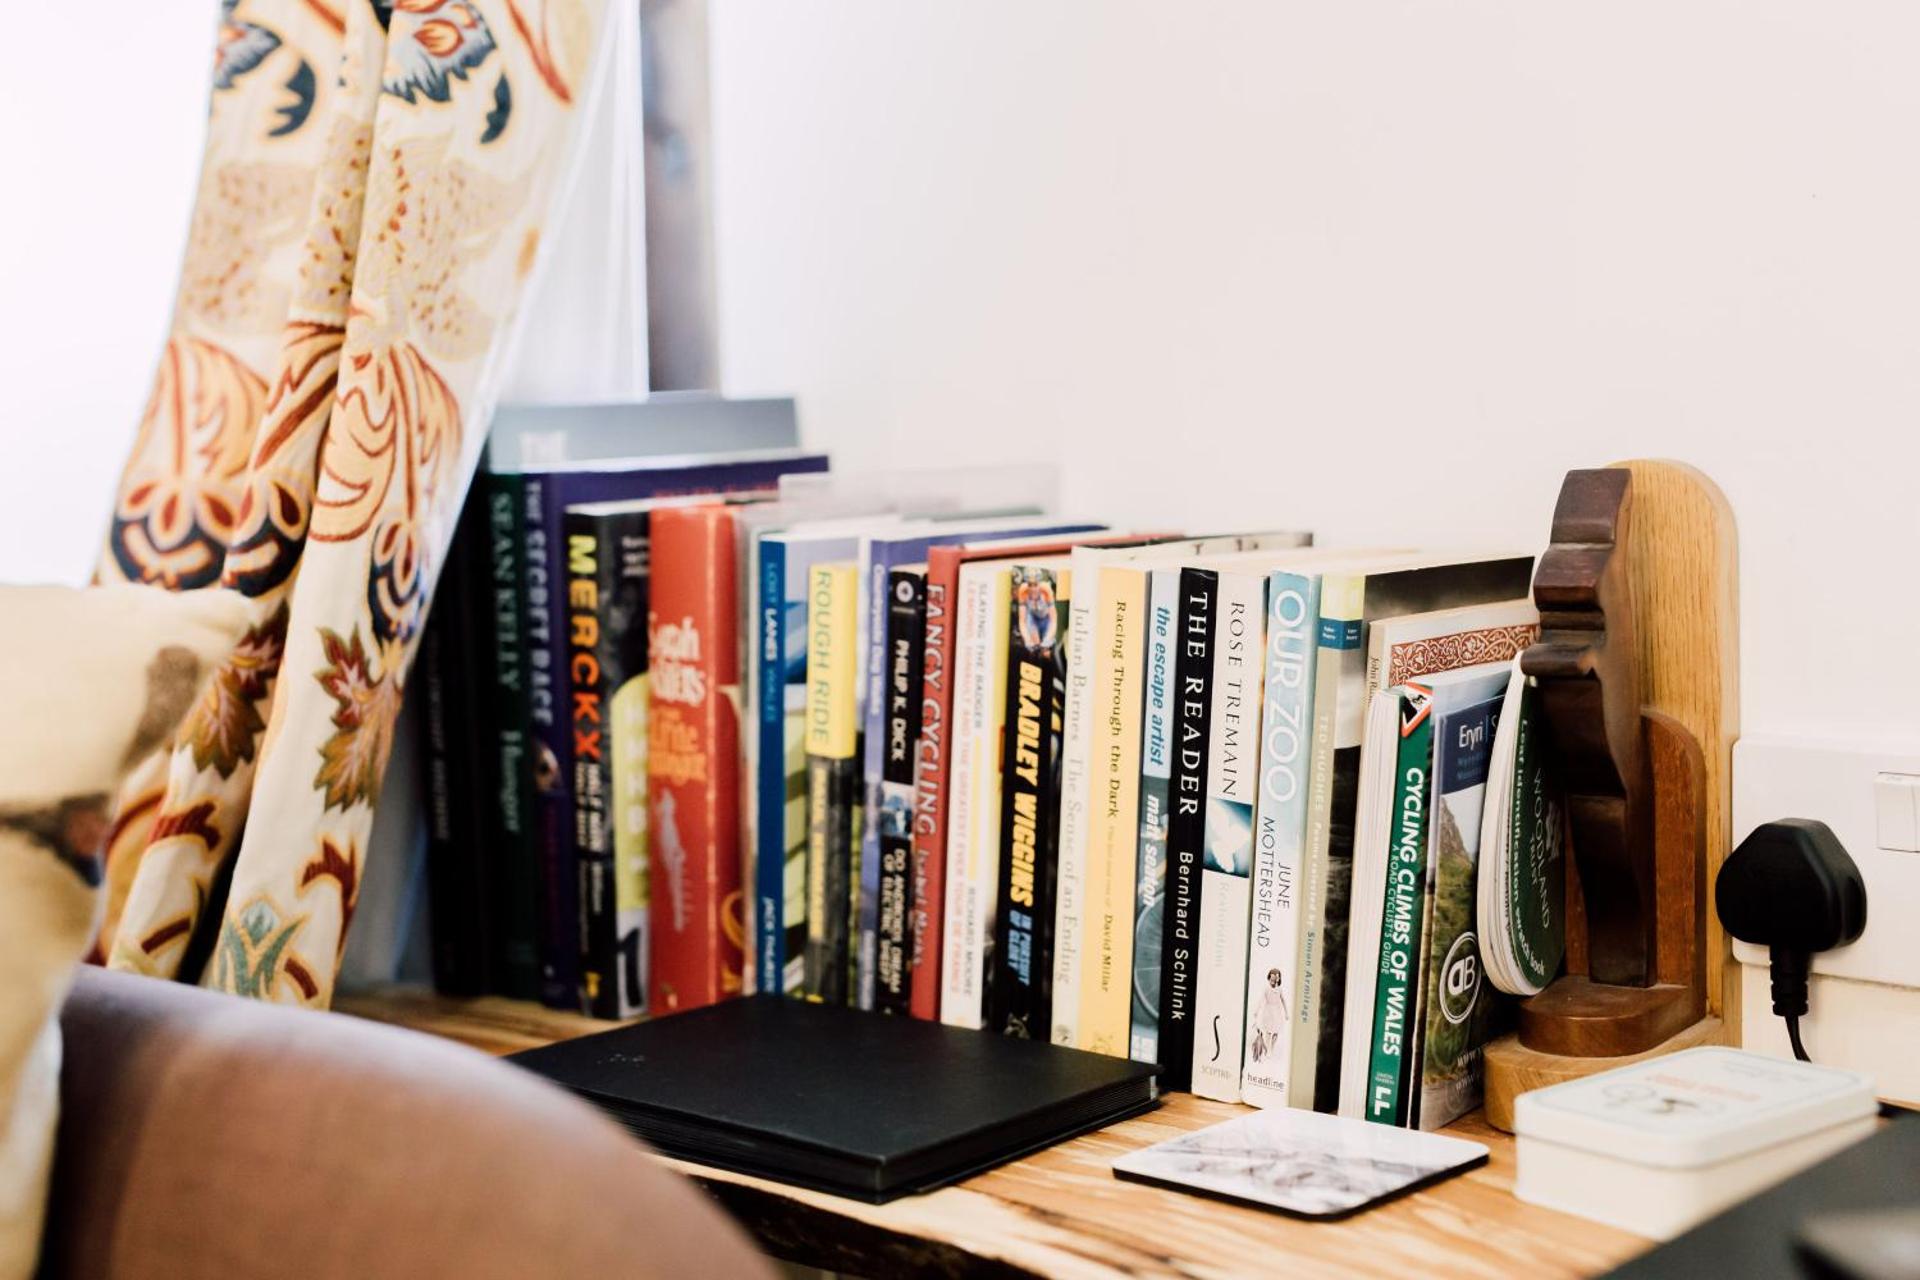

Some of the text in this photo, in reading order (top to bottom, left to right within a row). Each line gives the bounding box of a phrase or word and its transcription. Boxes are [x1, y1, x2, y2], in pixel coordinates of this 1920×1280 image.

[492, 493, 521, 690] SEAN KELLY
[526, 529, 550, 641] SECRET
[568, 534, 603, 758] MERCKX
[765, 608, 778, 661] LANES
[812, 571, 833, 745] ROUGH RIDE
[974, 583, 987, 728] SLAYING THE BADGER
[1112, 600, 1127, 659] Racing
[530, 649, 553, 727] RACE
[891, 639, 909, 761] PHILIP K. DICK
[1070, 607, 1089, 741] Julian Barnes
[1110, 666, 1125, 736] Through
[1150, 606, 1171, 766] the escape artist
[1222, 602, 1245, 797] ROSE TREMAIN
[1265, 590, 1306, 803] OUR ZOO
[1369, 656, 1380, 679] John
[917, 584, 945, 834] FANCY CYCLING
[1179, 592, 1208, 816] THE READER
[1459, 721, 1484, 750] Eryri
[1109, 745, 1121, 772] the
[1314, 716, 1329, 811] TED HUGHES
[1518, 719, 1529, 763] Leaf
[499, 731, 524, 834] Hunger
[1010, 661, 1042, 907] BRADLEY WIGGINS
[1108, 779, 1121, 818] Dark
[1056, 758, 1084, 984] The Sense of an Ending
[1311, 822, 1322, 859] Poems
[1389, 855, 1399, 884] ROAD
[1529, 836, 1539, 885] TRUST
[1532, 768, 1551, 929] WOODLAND
[1142, 843, 1158, 908] seaton
[1256, 816, 1275, 949] MOTTERSHEAD
[1276, 862, 1292, 909] JUNE
[1309, 864, 1318, 910] selected
[964, 887, 976, 997] RICHARD MOORE
[1103, 914, 1114, 951] David
[1170, 852, 1194, 1020] Bernhard Schlink
[1383, 767, 1424, 1056] CYCLING CLIMBS OF WALES
[1385, 887, 1397, 938] CYCLIST'S
[889, 946, 902, 992] DREAM
[1008, 929, 1020, 971] GLORY
[1019, 932, 1032, 985] PURSUIT
[1101, 954, 1112, 992] Millar
[1305, 930, 1316, 966] Simon
[1381, 941, 1392, 974] GUIDE
[1300, 970, 1312, 1024] Armitage
[1246, 1073, 1285, 1090] headline
